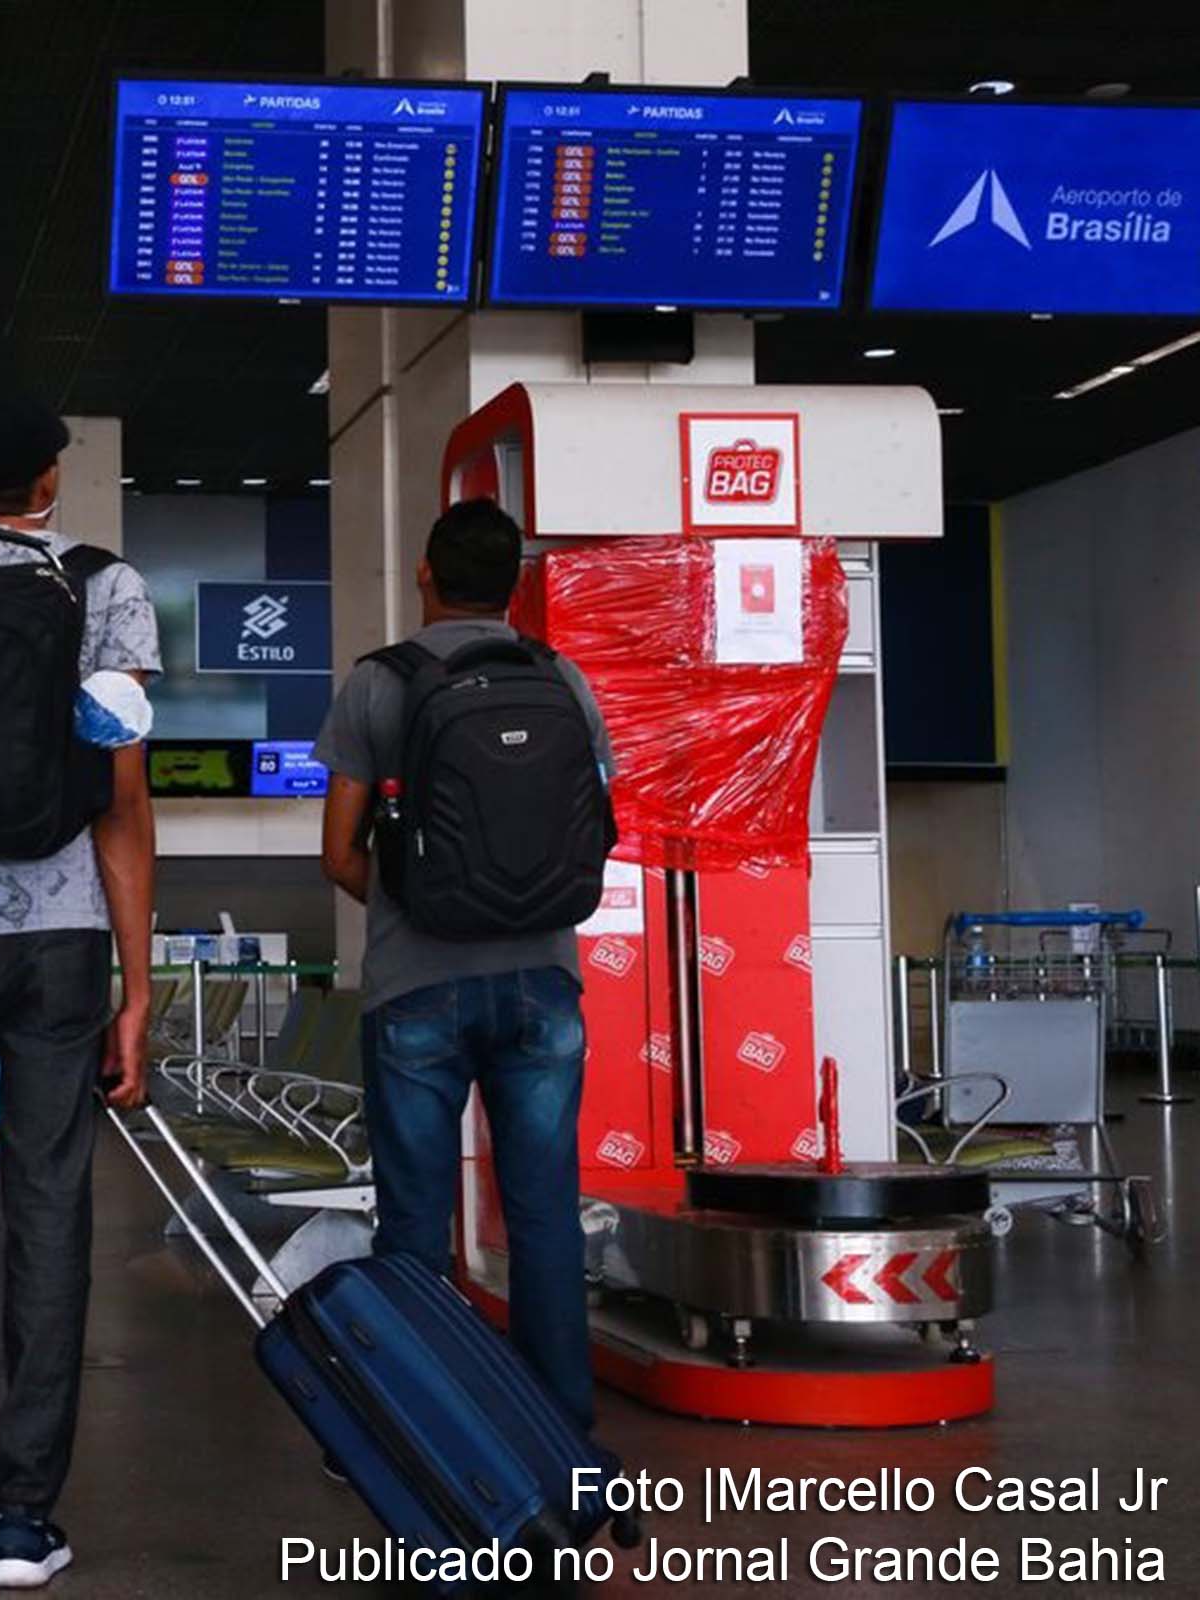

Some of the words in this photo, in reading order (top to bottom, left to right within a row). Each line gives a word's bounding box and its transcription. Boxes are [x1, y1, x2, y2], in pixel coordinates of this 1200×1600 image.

[259, 96, 321, 110] PARTIDAS
[643, 106, 703, 119] PARTIDAS
[1051, 185, 1151, 208] Aeroporto
[1156, 188, 1182, 207] de
[1045, 211, 1171, 242] Brasília
[714, 455, 774, 469] PROTEC
[710, 470, 771, 496] BAG
[237, 643, 295, 662] ESTILO
[259, 760, 276, 773] 80
[593, 947, 627, 971] BAG
[742, 1042, 775, 1066] BAG
[601, 1141, 635, 1166] BAG
